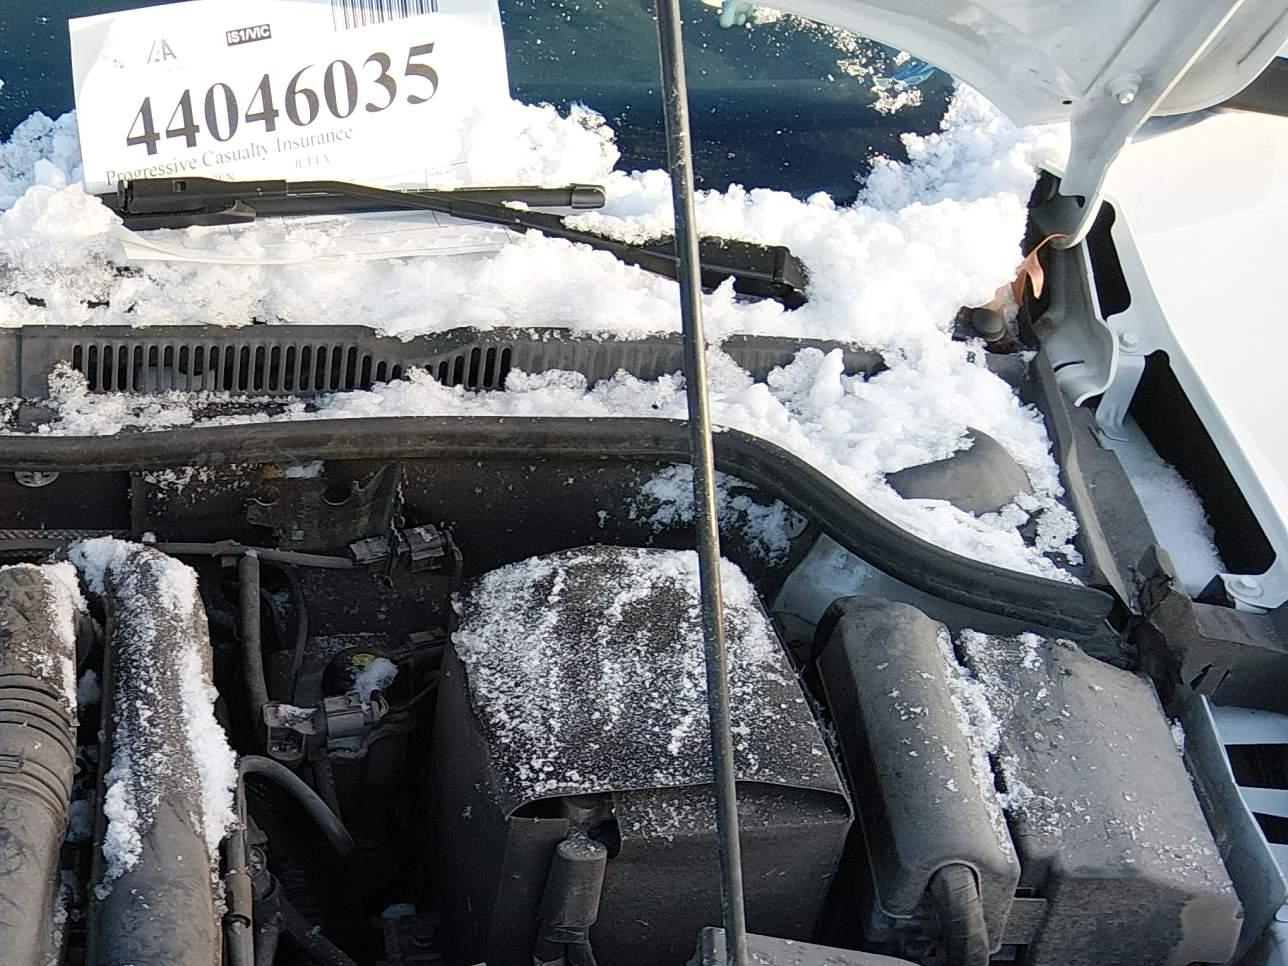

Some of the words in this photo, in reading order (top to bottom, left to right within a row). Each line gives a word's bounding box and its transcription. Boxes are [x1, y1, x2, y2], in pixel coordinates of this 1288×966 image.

[126, 42, 439, 156] 44046035
[105, 156, 198, 186] Progressive
[202, 142, 269, 168] Casualty
[277, 127, 353, 153] Insurance
